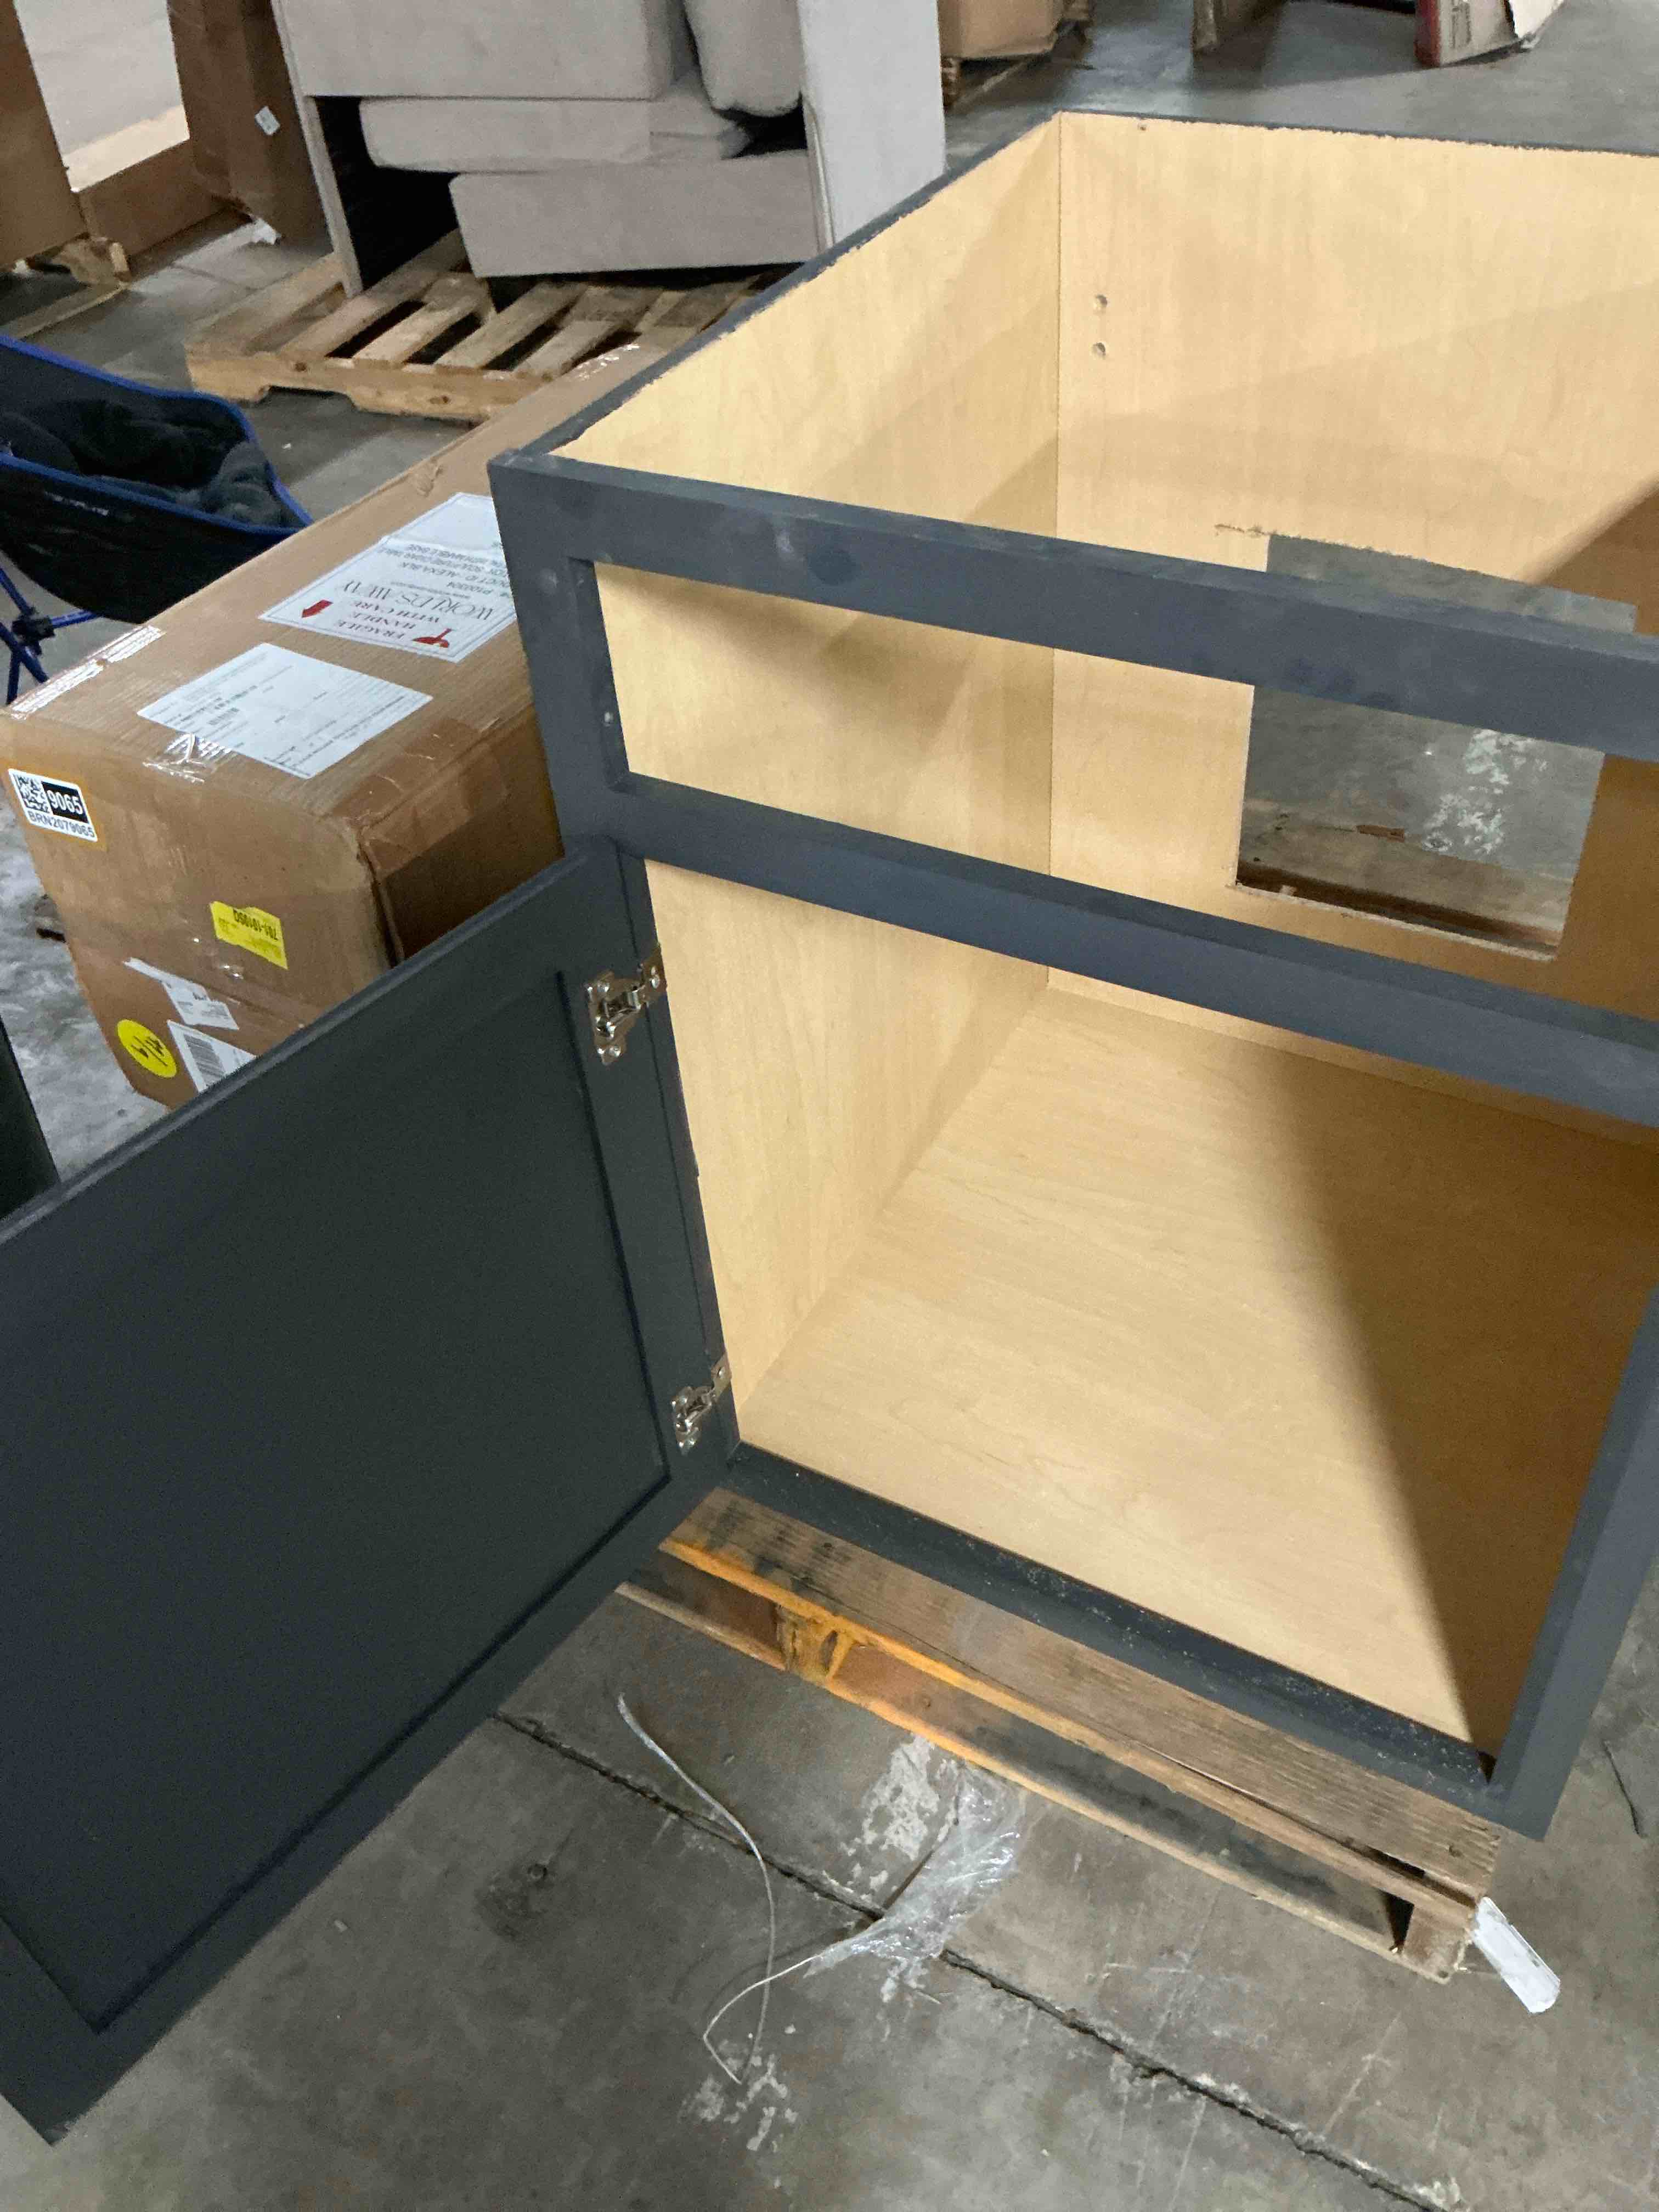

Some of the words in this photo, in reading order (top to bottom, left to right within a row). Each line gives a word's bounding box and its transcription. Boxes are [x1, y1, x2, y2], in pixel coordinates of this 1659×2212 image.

[351, 600, 396, 614] CARE
[396, 610, 440, 623] WITH
[338, 619, 405, 639] FRAGILE
[353, 611, 416, 629] HANDLE
[47, 789, 83, 815] 9065
[28, 811, 95, 838] BRN2079065
